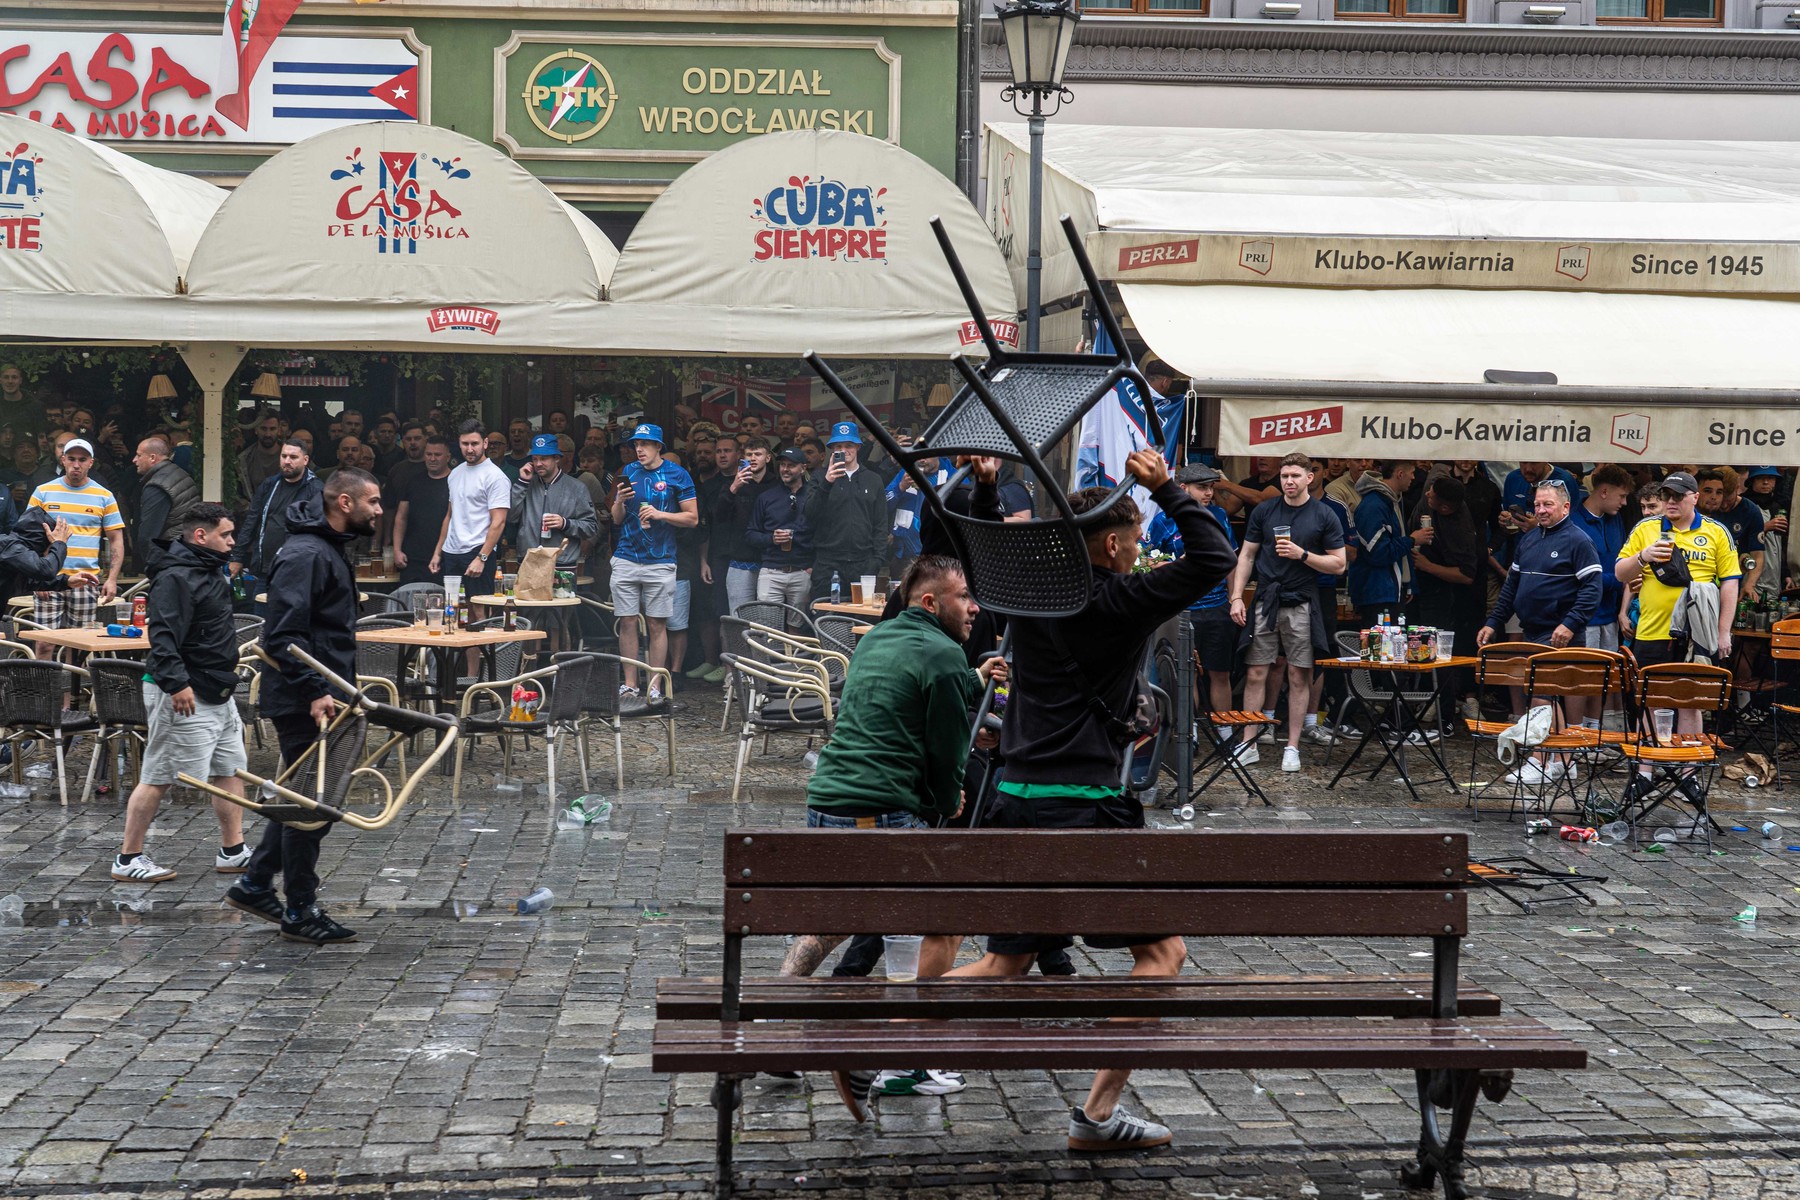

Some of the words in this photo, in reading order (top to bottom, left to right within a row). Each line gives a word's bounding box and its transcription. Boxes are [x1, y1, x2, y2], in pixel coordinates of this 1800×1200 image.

[0, 32, 211, 112] CASA
[682, 67, 831, 96] ODDZIAŁ
[532, 86, 607, 108] PTTK
[86, 110, 226, 138] MUSICA
[638, 106, 874, 135] WROCŁAWSKI
[336, 178, 462, 226] CASA
[766, 182, 876, 226] CUBA
[327, 223, 355, 237] DE
[362, 224, 388, 237] LA
[393, 223, 470, 240] MUSICA
[754, 228, 887, 260] SIEMPRE
[1128, 244, 1190, 266] PERŁA
[1245, 252, 1269, 263] PRL
[1314, 248, 1516, 273] Klubo-Kawiarnia
[1561, 258, 1585, 270] PRL
[1630, 253, 1700, 276] Since
[1705, 255, 1765, 277] 1945
[436, 307, 493, 327] ŻYWIEC
[1259, 411, 1333, 439] PERŁA
[1360, 415, 1592, 444] Klubo-Kawiarnia
[1617, 428, 1645, 441] PRL
[1707, 422, 1786, 448] Since
